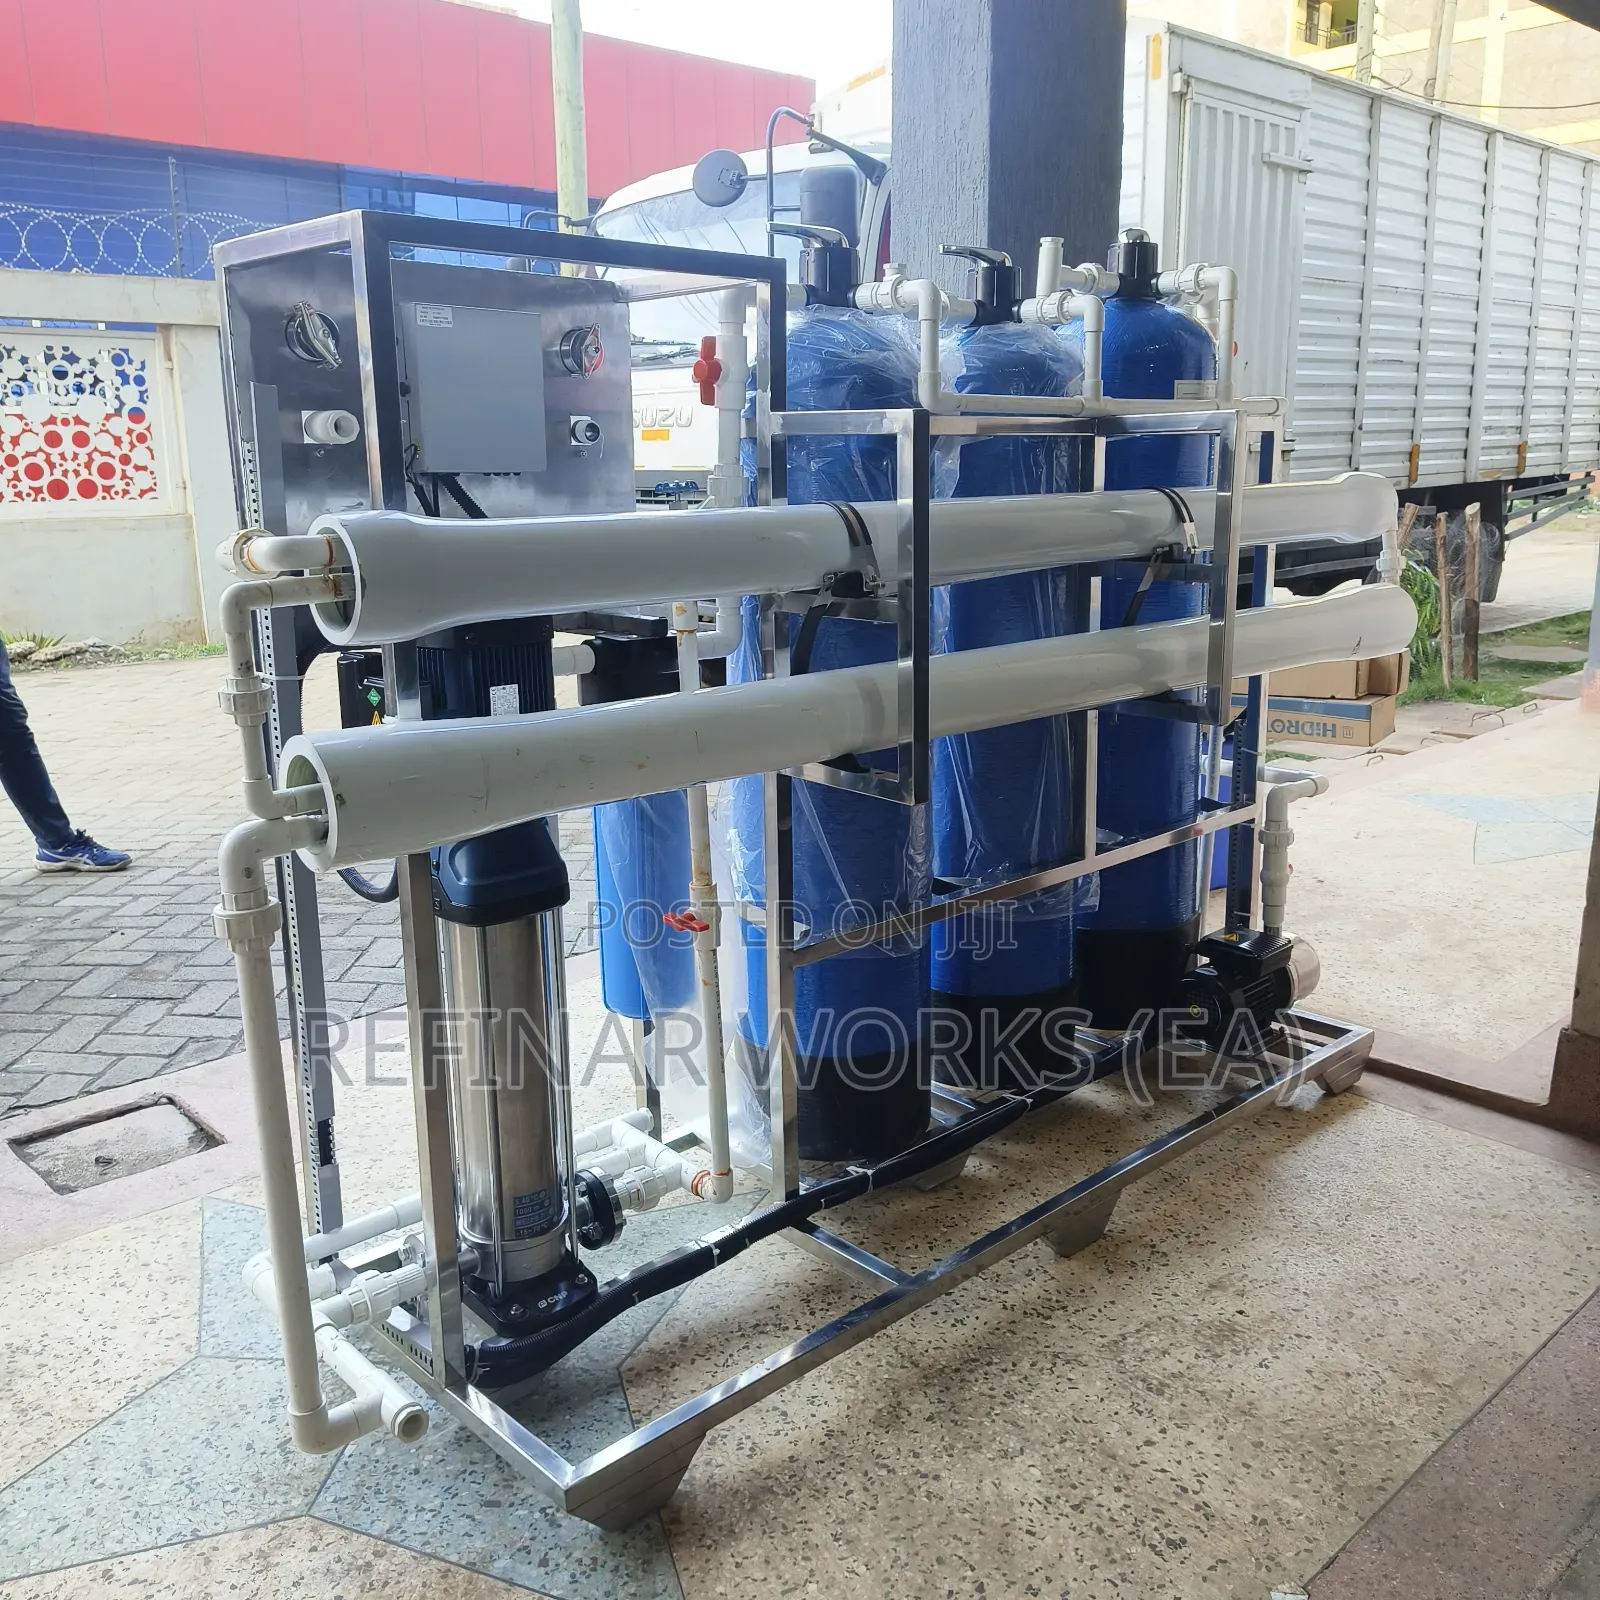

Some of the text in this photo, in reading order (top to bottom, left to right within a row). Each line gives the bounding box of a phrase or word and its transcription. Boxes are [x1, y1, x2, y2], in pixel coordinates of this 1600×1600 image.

[633, 405, 694, 428] SUZU
[1267, 718, 1337, 738] HiDRO
[547, 1290, 568, 1303] CNP
